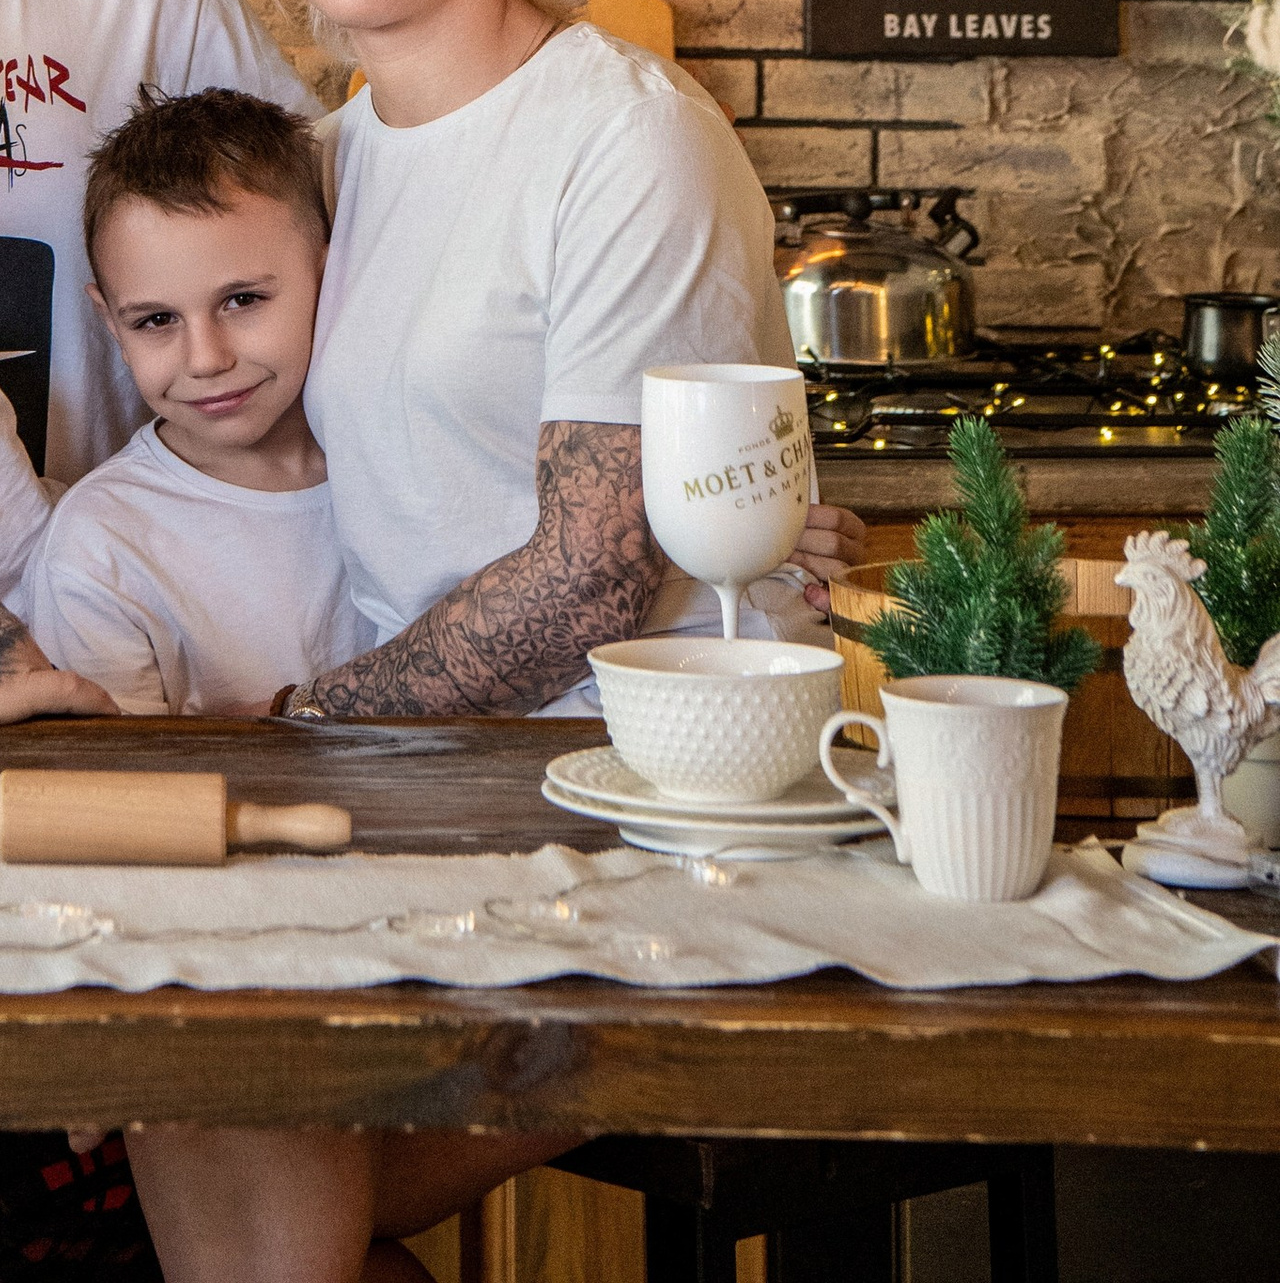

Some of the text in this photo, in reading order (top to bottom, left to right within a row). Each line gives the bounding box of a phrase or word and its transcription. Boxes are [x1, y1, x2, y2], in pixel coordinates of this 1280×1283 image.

[883, 13, 1053, 40] BAY LEAVES
[683, 461, 755, 502] MOËT
[763, 459, 777, 479] &
